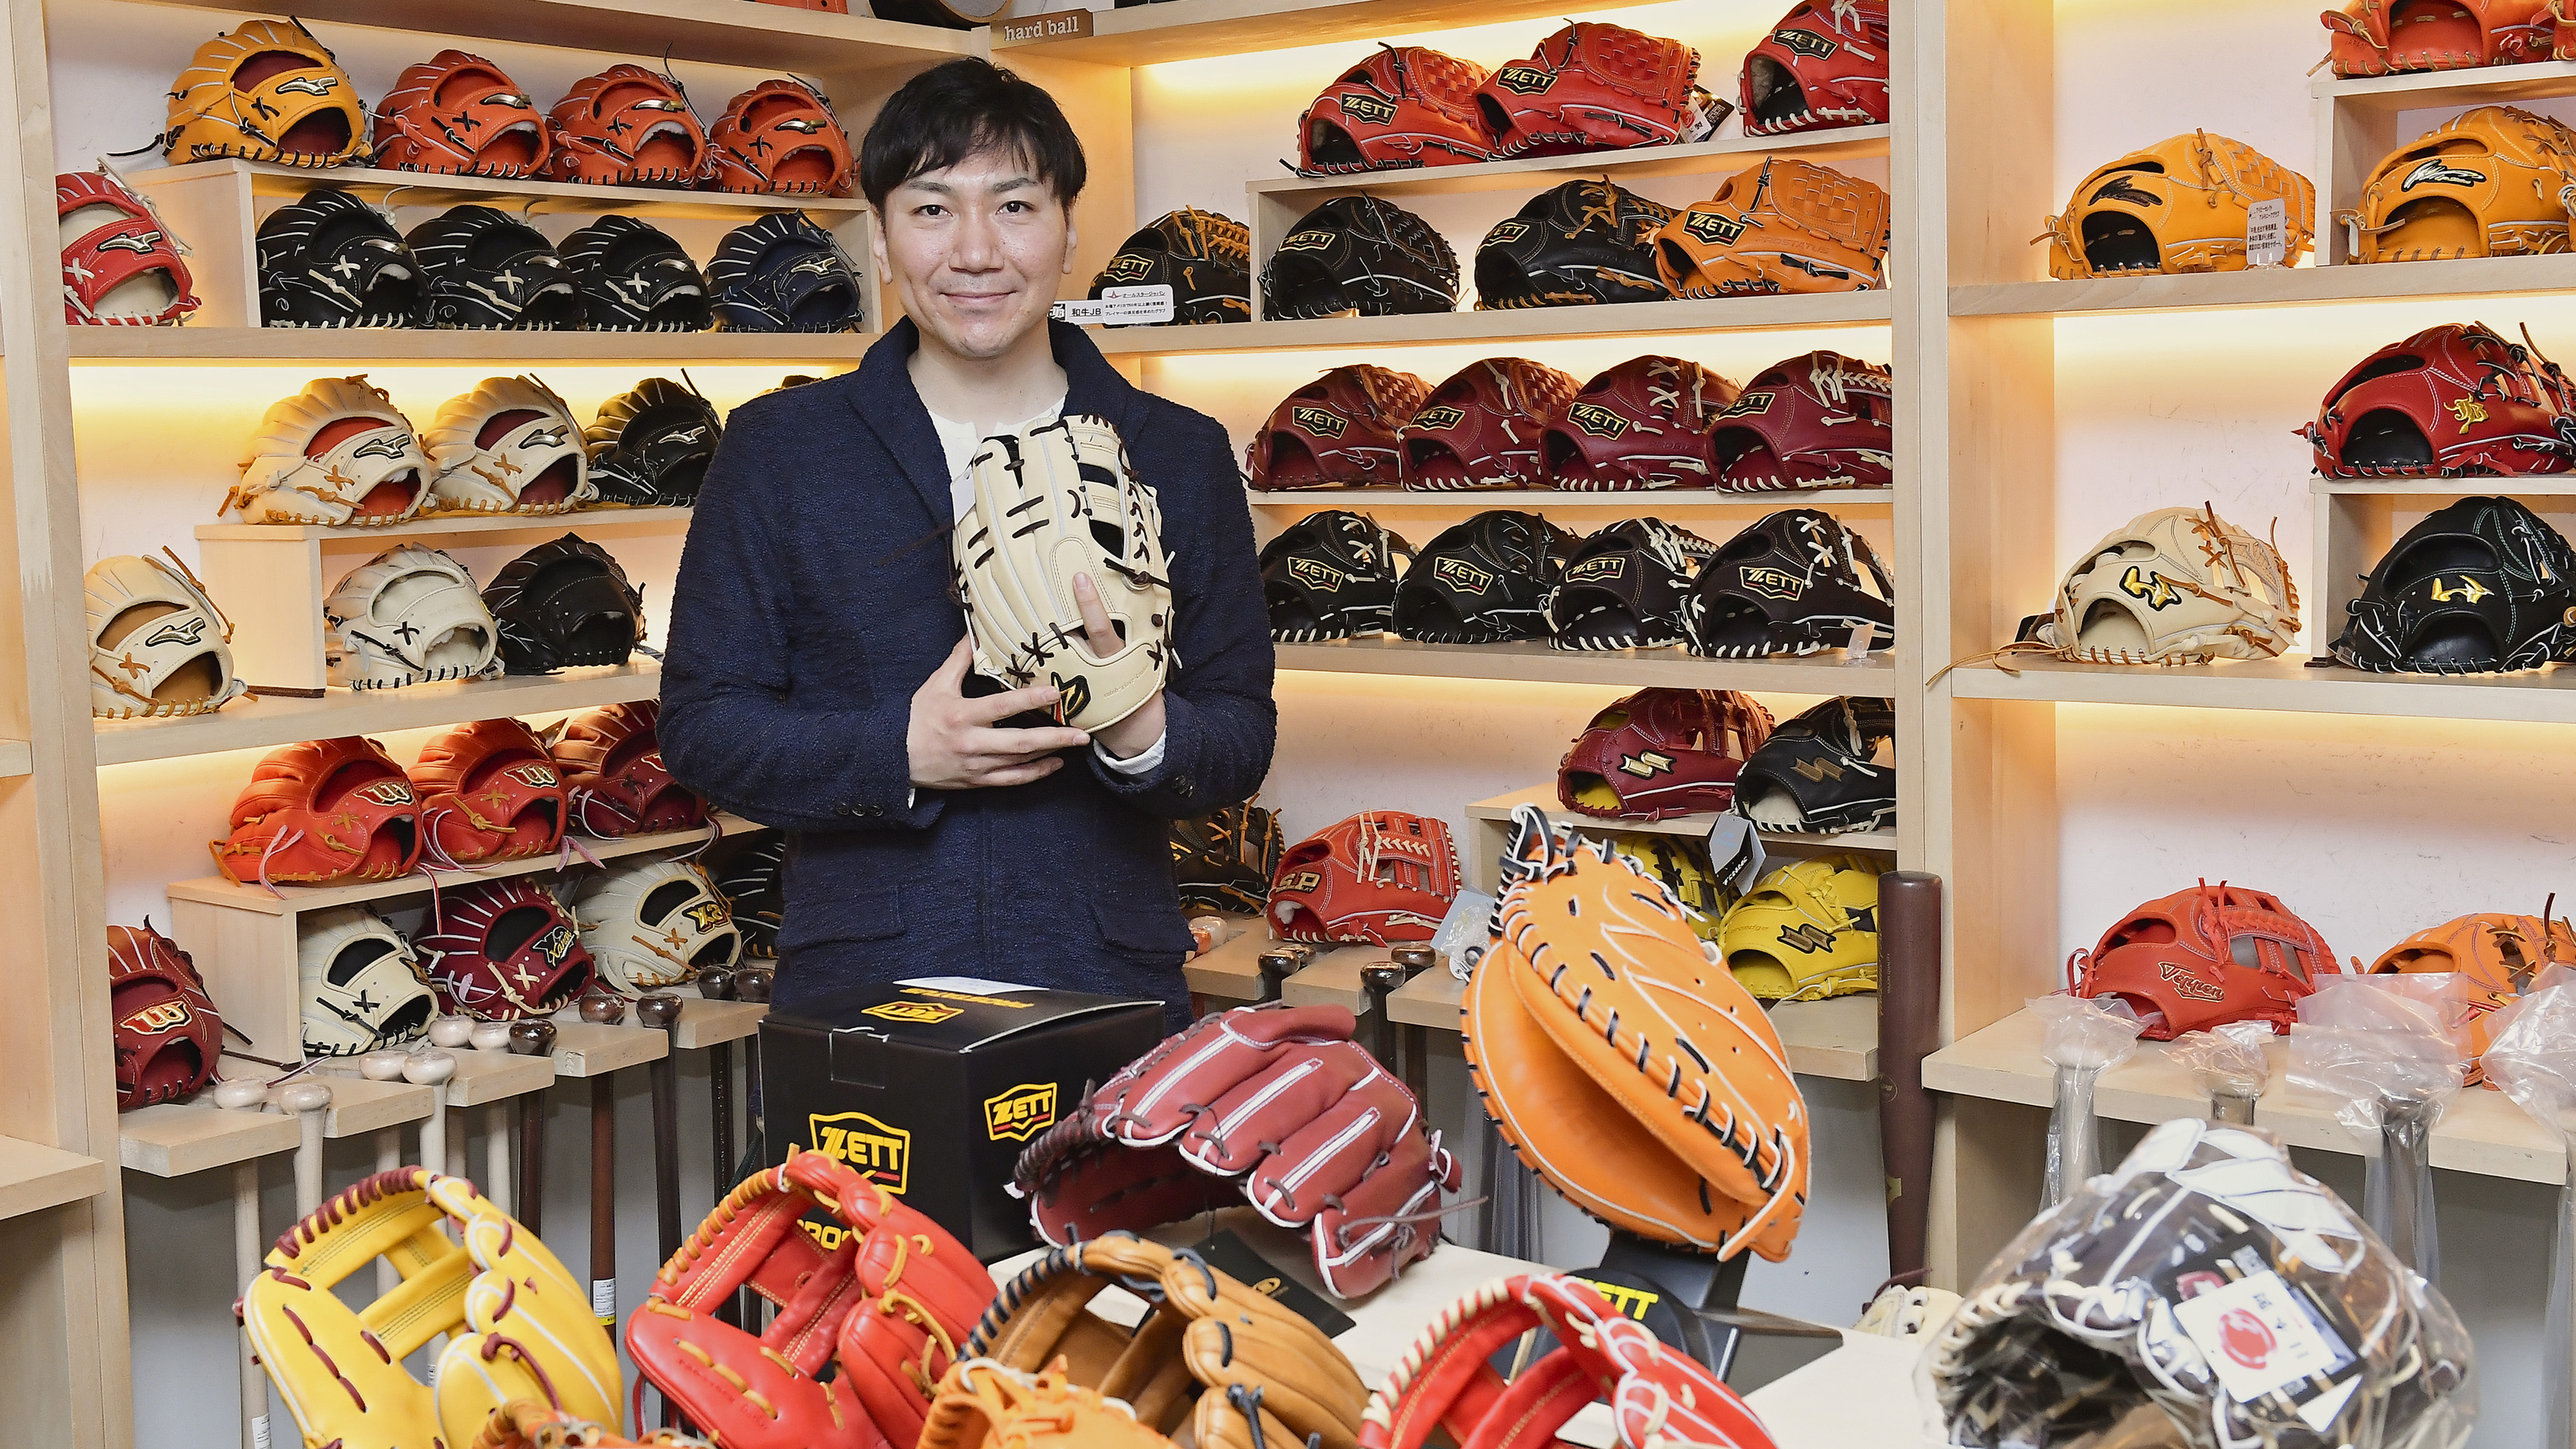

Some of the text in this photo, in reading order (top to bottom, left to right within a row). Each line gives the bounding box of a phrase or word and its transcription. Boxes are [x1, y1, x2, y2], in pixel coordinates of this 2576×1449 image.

[1005, 16, 1079, 41] hard ball
[1777, 31, 1833, 52] ZETT
[1503, 68, 1552, 89] ZETT
[1344, 96, 1392, 118] ZETT
[1690, 214, 1741, 237] ZETT
[1287, 233, 1330, 243] ZETT
[1109, 258, 1149, 273] ZETT
[1072, 308, 1101, 317] 和牛JB
[1299, 409, 1344, 431] ZETT
[1576, 405, 1624, 431] ZETT
[1295, 559, 1341, 583] ZETT
[1441, 560, 1488, 586] ZETT
[1572, 560, 1620, 575] ZETT
[1748, 570, 1801, 591] ZETT
[993, 1090, 1052, 1125] ZETT
[820, 1127, 903, 1170] ZETT
